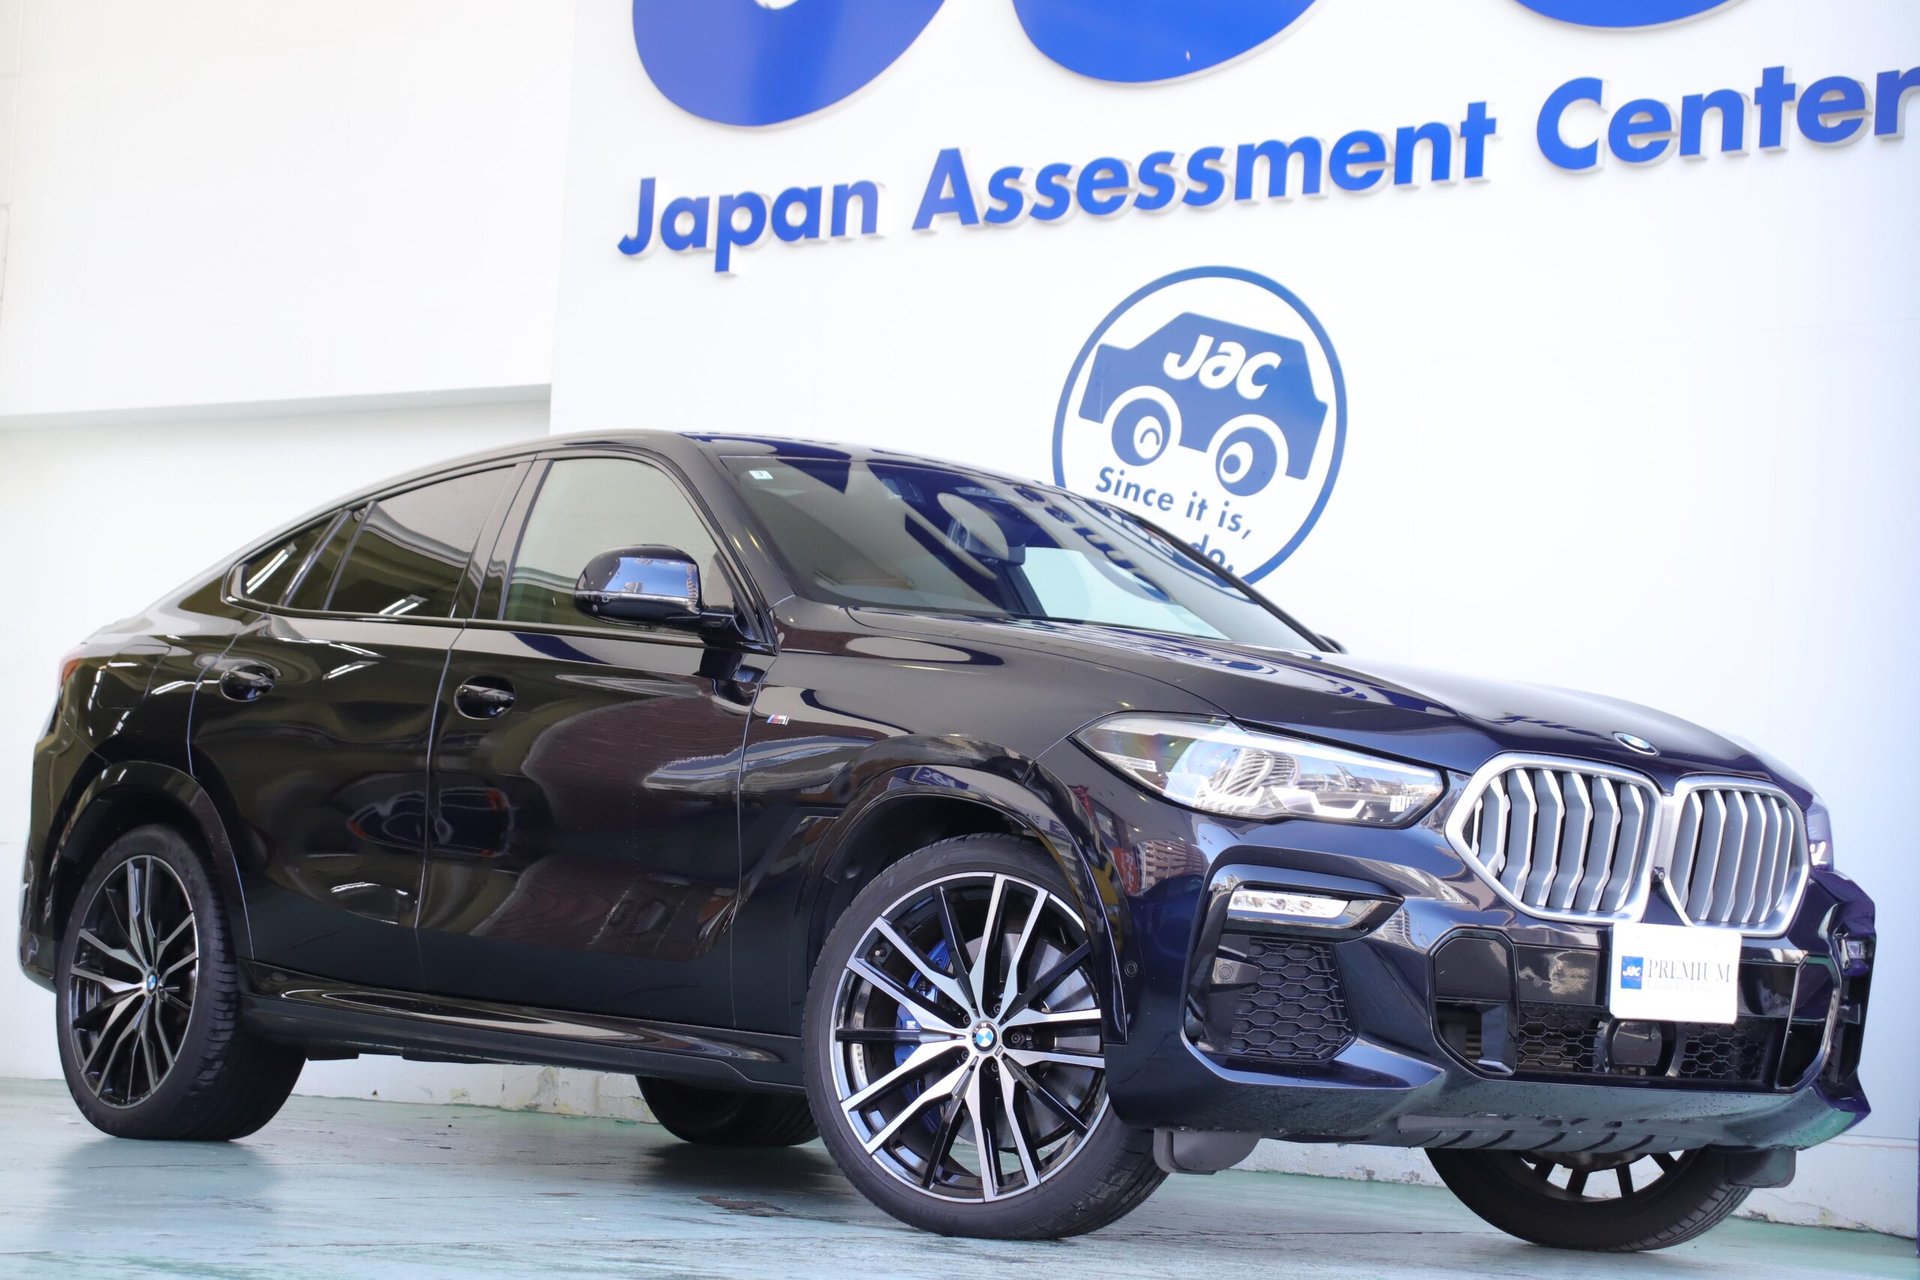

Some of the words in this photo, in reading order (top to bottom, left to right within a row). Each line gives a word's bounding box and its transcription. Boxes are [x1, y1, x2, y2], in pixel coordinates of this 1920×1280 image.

[617, 178, 879, 274] Japan
[912, 101, 1498, 231] Assessment
[1536, 66, 1920, 171] Center
[1095, 466, 1175, 512] Since
[1185, 491, 1209, 522] it
[1217, 500, 1253, 540] is,
[1647, 958, 1731, 983] PREMIUM
